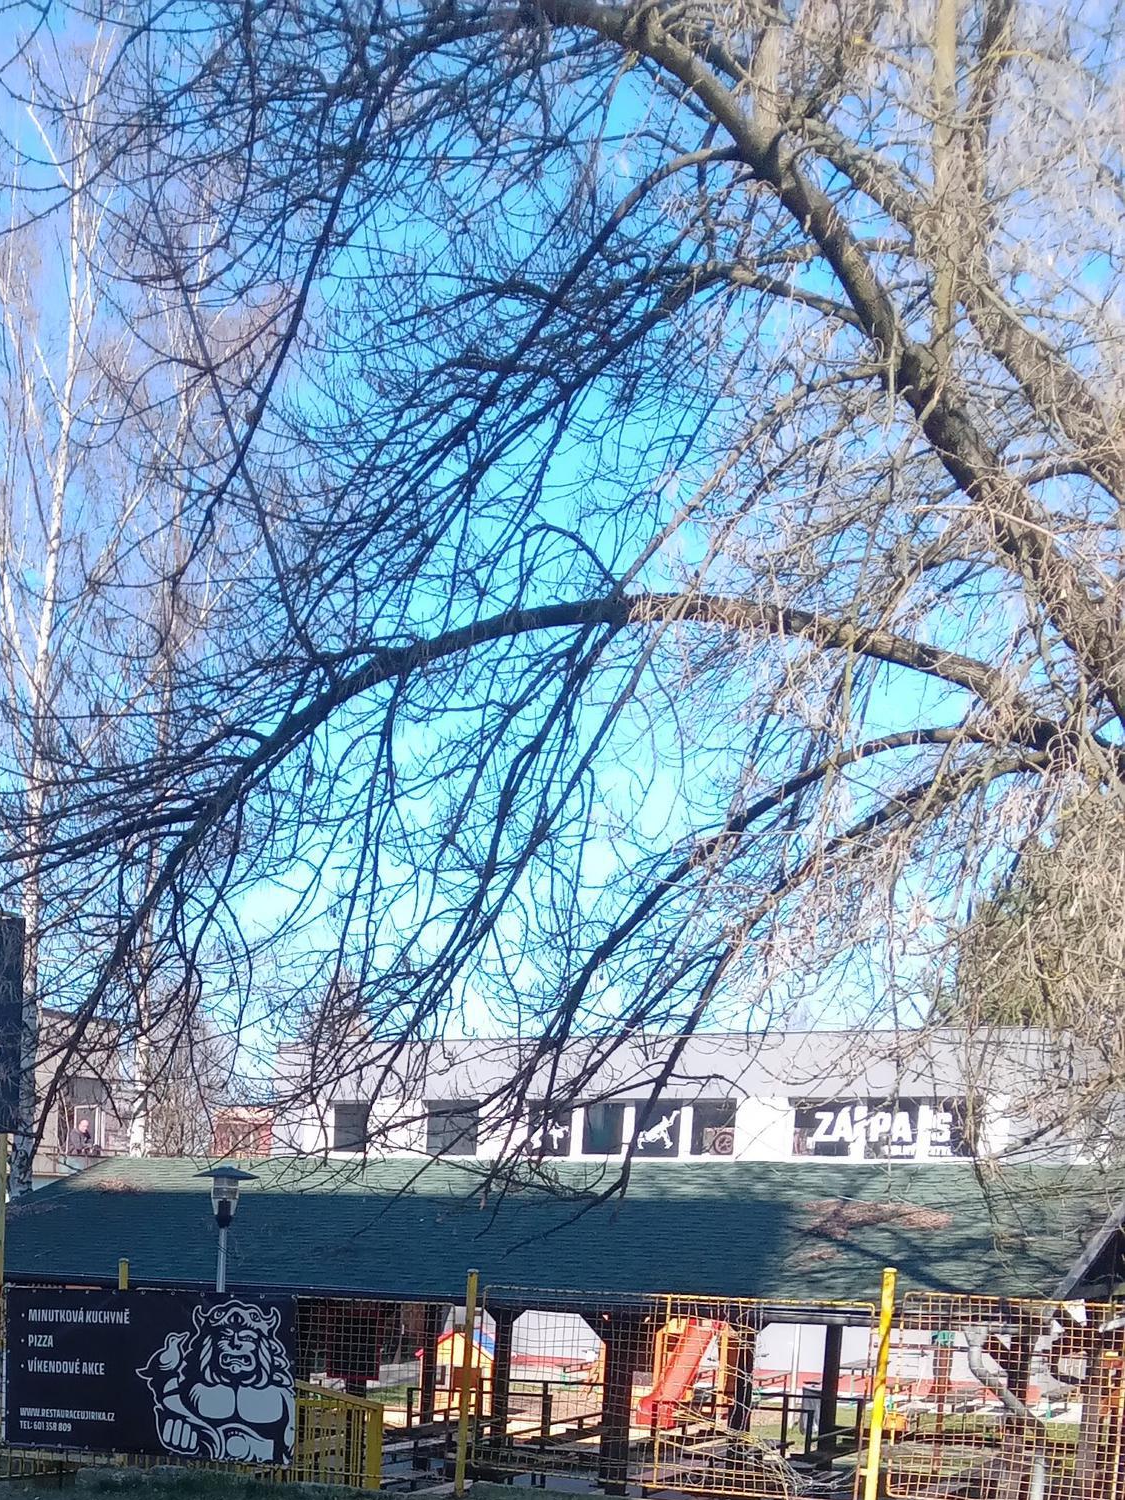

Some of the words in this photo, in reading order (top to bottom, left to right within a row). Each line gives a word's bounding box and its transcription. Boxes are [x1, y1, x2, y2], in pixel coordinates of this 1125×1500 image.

[28, 1307, 84, 1323] MINUTKOVÁ
[85, 1308, 130, 1325] KUCHYNĚ
[28, 1334, 54, 1348] PIZZA
[27, 1356, 81, 1375] VÍKENDOVÉ
[82, 1362, 105, 1376] AKCE
[19, 1420, 33, 1430] TEL:
[33, 1422, 45, 1431] 601
[45, 1422, 57, 1431] 358
[58, 1422, 72, 1432] 809
